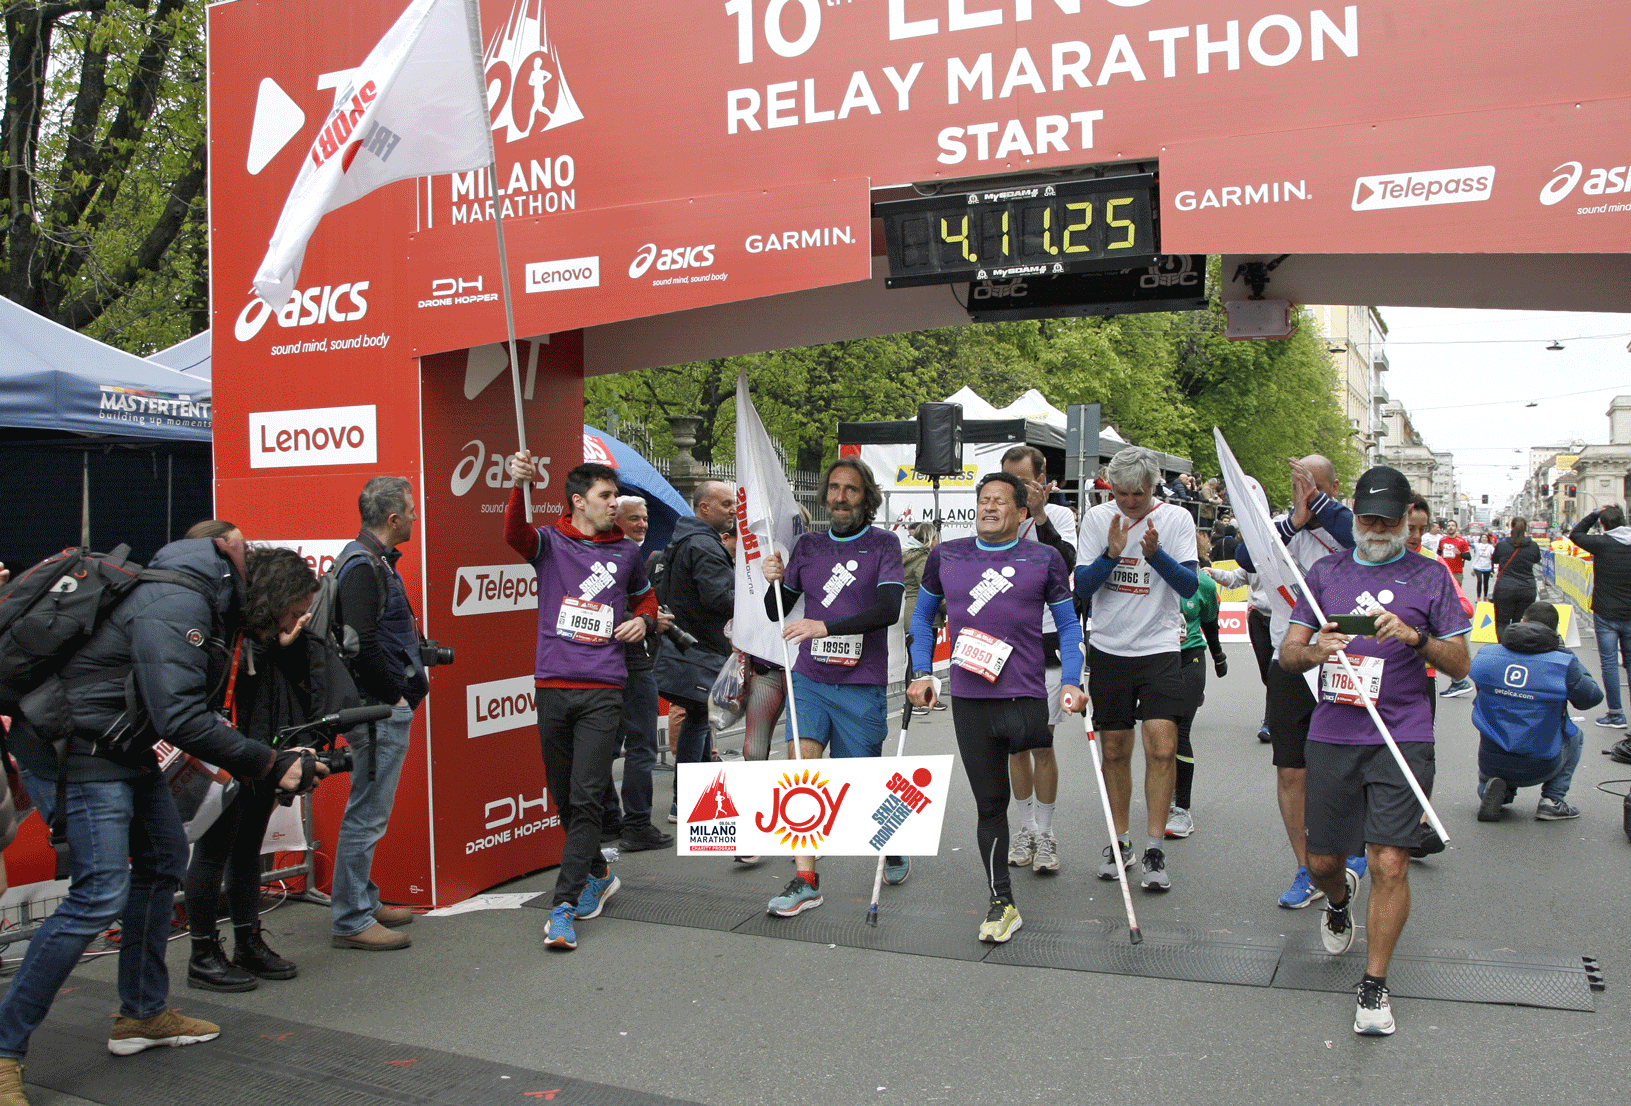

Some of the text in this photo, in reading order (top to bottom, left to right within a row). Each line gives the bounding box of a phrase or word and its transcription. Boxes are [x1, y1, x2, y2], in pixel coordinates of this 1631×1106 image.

[727, 5, 1359, 134] RELAY MARATHON
[936, 109, 1104, 165] START
[452, 155, 574, 203] MILANO
[1378, 175, 1489, 202] Telepass
[452, 189, 575, 225] MARATHON
[1577, 204, 1607, 215] sound
[532, 267, 593, 285] Lenovo
[418, 293, 499, 308] DRONE HOPPER
[271, 333, 390, 356] sound mind, sound body
[100, 392, 212, 419] MASTERTENT
[99, 410, 212, 428] building up moments
[261, 424, 364, 453] Lenovo
[481, 502, 504, 513] sound
[1113, 571, 1138, 583] 1786C
[570, 615, 601, 631] 1895B
[822, 641, 850, 655] 1895C
[961, 644, 992, 664] 1895D
[1494, 688, 1534, 700] getpica.com
[465, 830, 511, 854] DRONE
